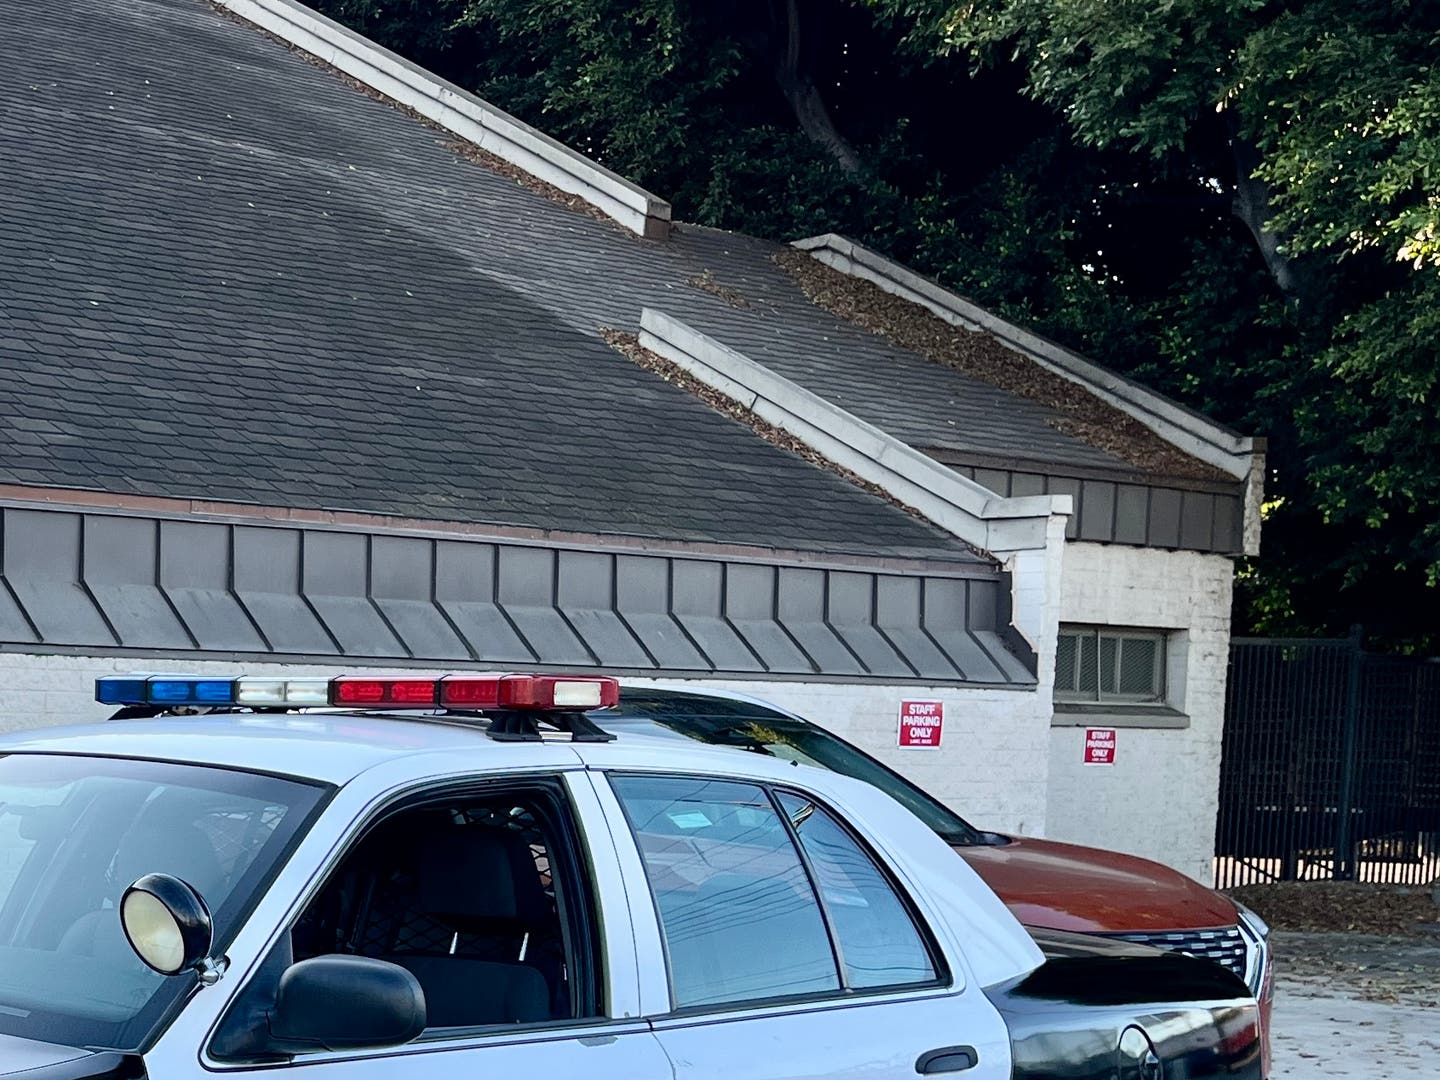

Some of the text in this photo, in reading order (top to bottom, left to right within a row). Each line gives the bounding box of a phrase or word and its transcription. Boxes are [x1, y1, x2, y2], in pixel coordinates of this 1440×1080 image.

[909, 704, 935, 715] STAFF
[903, 716, 940, 727] PARKING
[910, 727, 933, 738] ONLY
